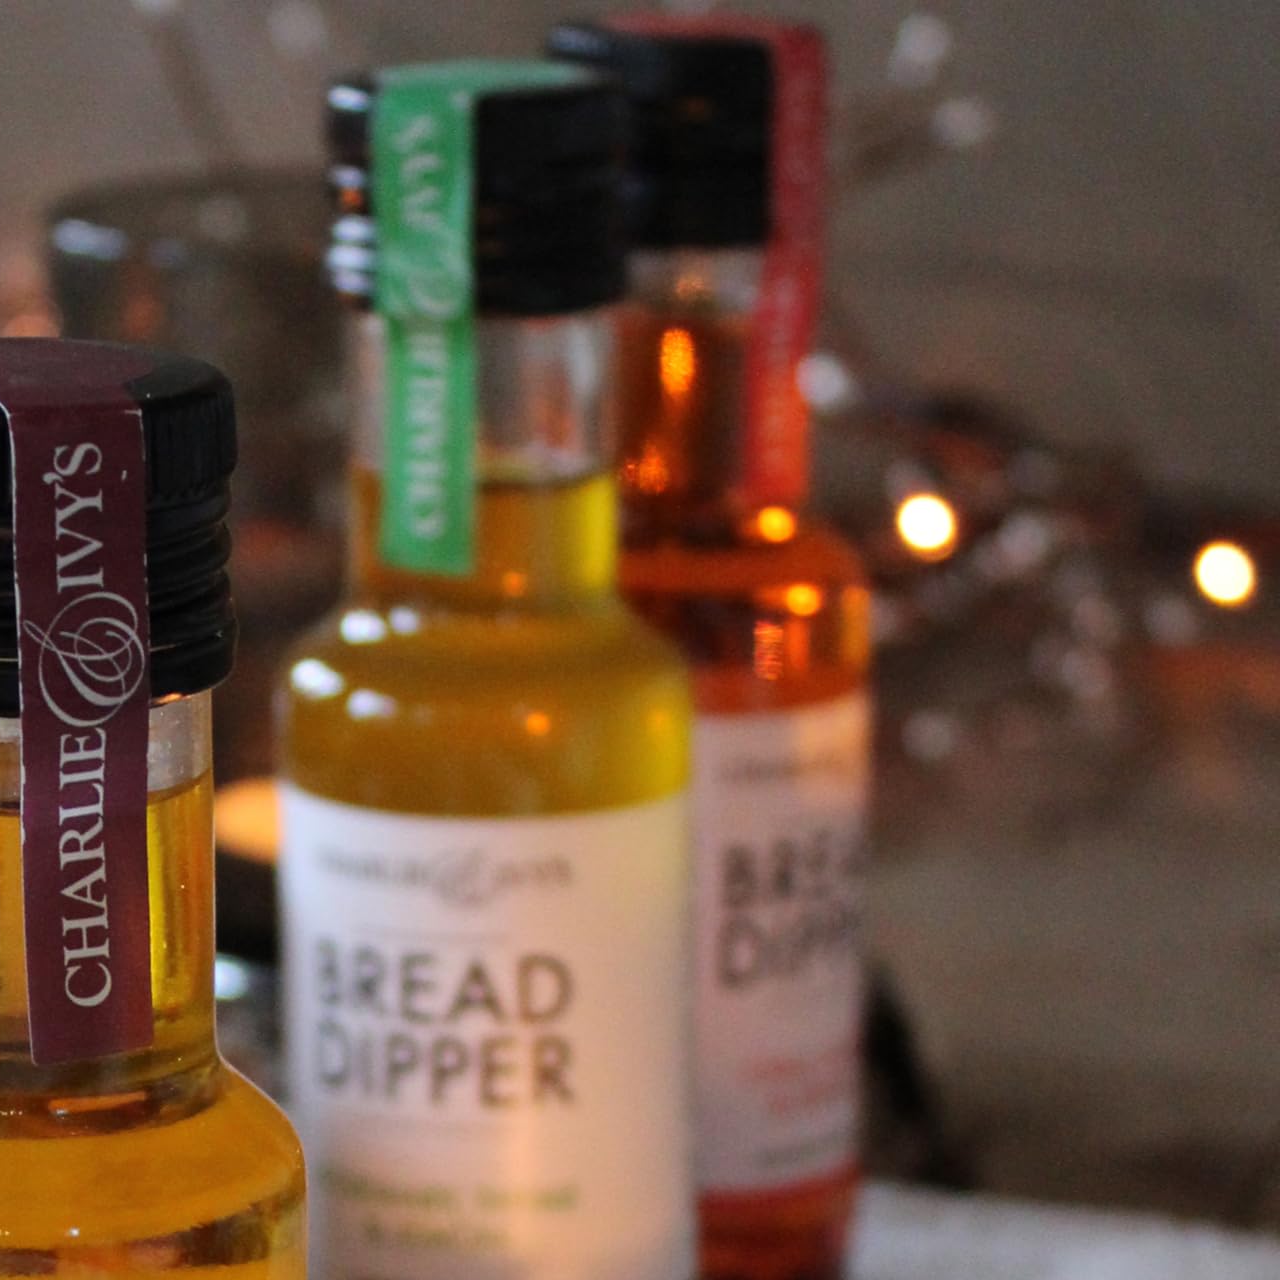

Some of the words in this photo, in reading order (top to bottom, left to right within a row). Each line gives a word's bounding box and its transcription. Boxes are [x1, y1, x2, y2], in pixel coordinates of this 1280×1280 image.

[43, 441, 104, 593] IVY'S
[23, 592, 145, 727] &
[58, 727, 112, 1008] CHARLIE
[315, 938, 576, 1025] BREAD
[316, 1024, 576, 1108] DIPPER
